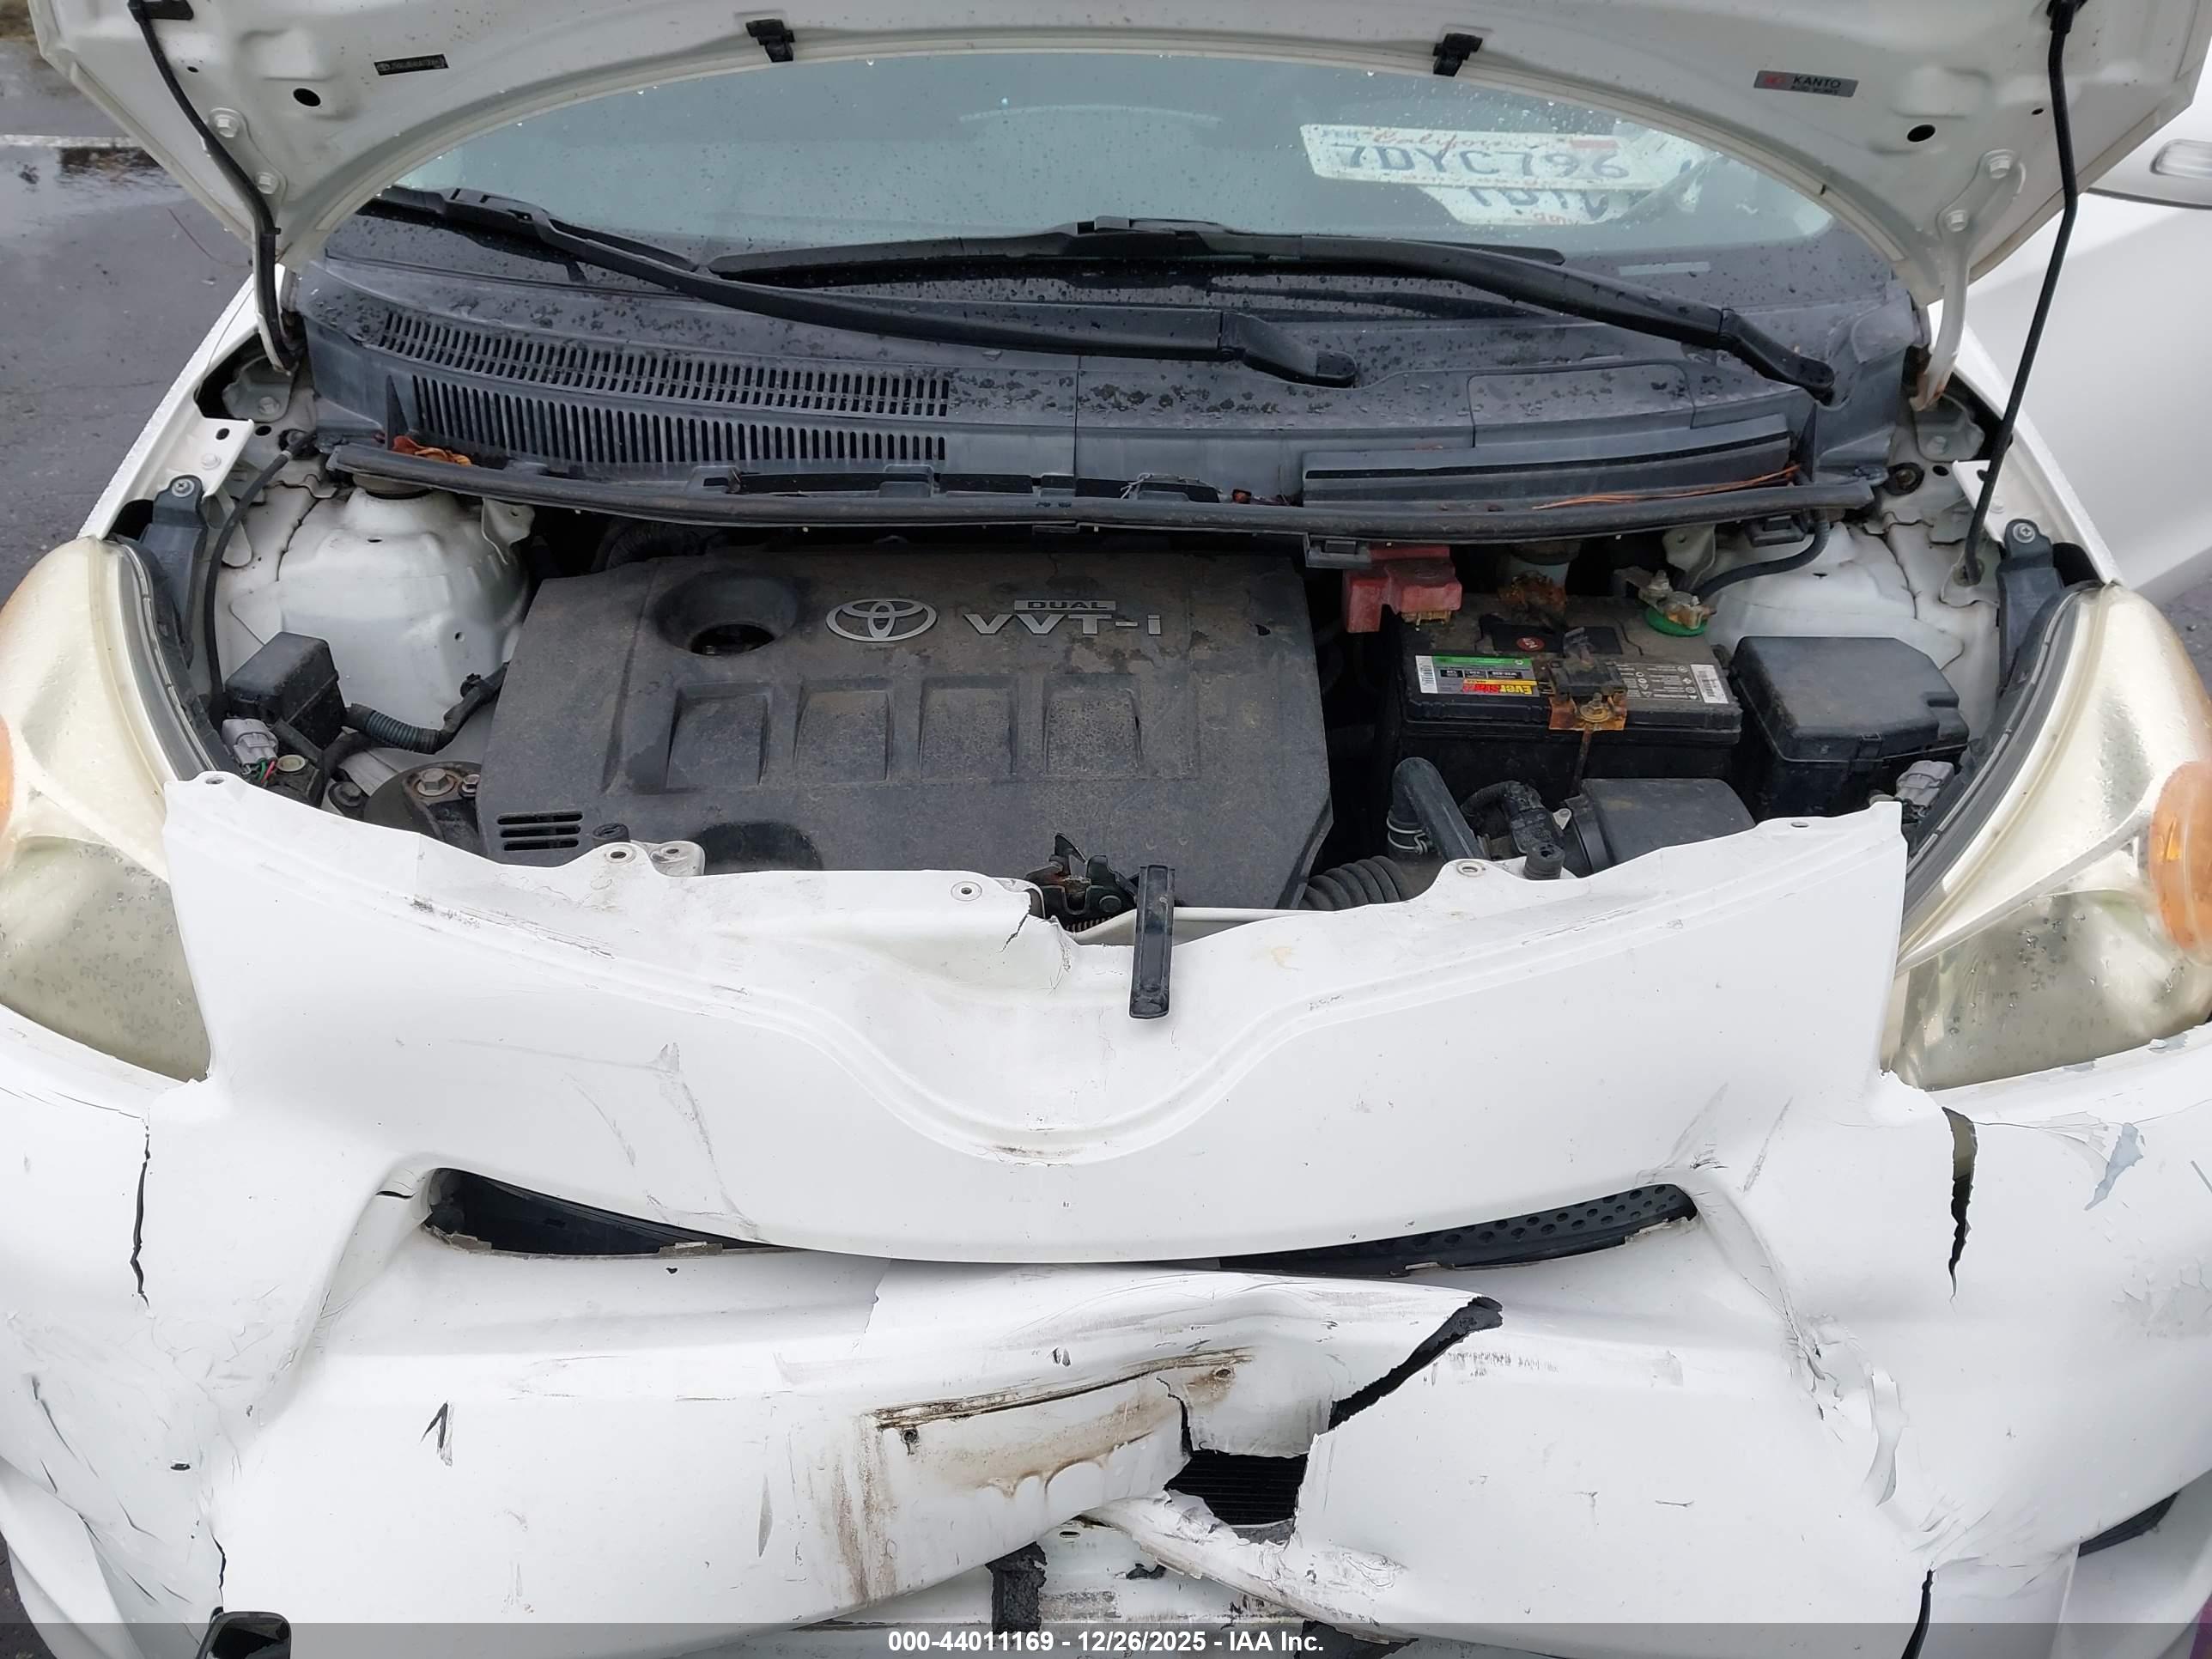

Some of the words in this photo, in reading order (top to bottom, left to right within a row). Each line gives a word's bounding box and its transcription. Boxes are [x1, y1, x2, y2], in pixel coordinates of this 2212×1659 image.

[1793, 75, 1841, 88] KANTO
[1331, 143, 1629, 179] 7DYC796
[1026, 600, 1109, 610] DUAL
